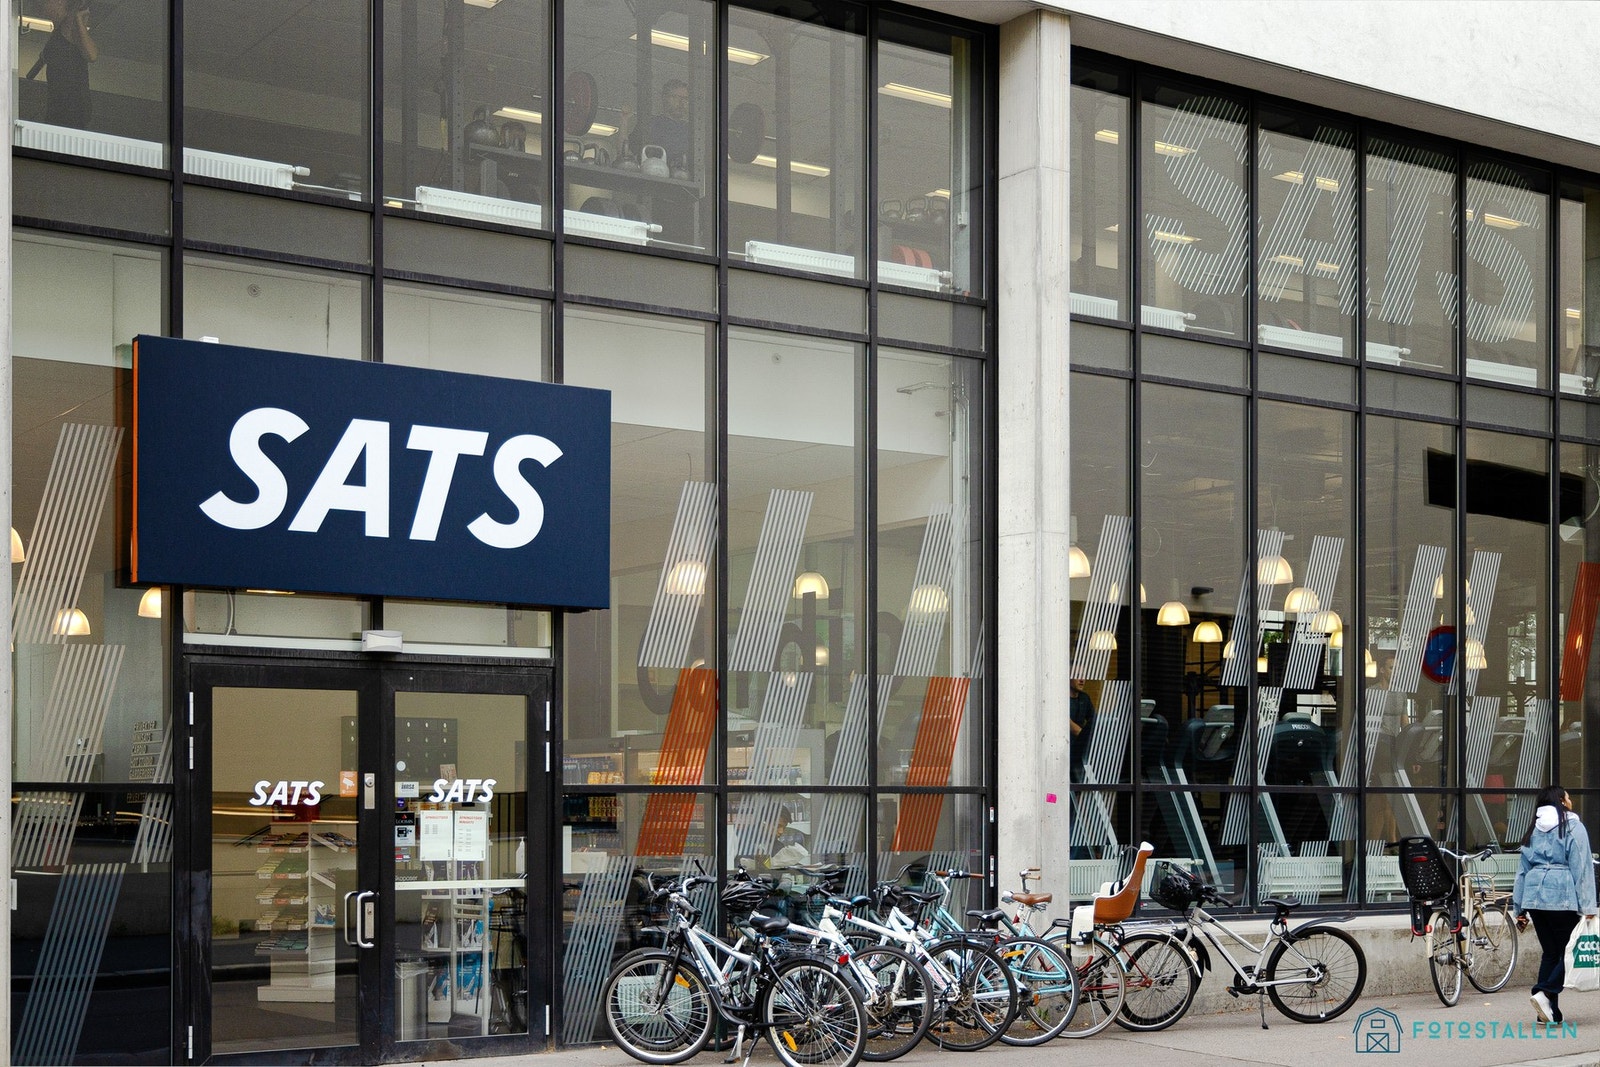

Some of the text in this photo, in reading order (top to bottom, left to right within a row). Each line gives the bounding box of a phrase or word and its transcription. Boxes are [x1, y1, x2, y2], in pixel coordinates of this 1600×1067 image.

[1146, 95, 1539, 343] SATS
[199, 407, 564, 549] SATS
[249, 780, 325, 806] SATS
[428, 778, 497, 803] SATS
